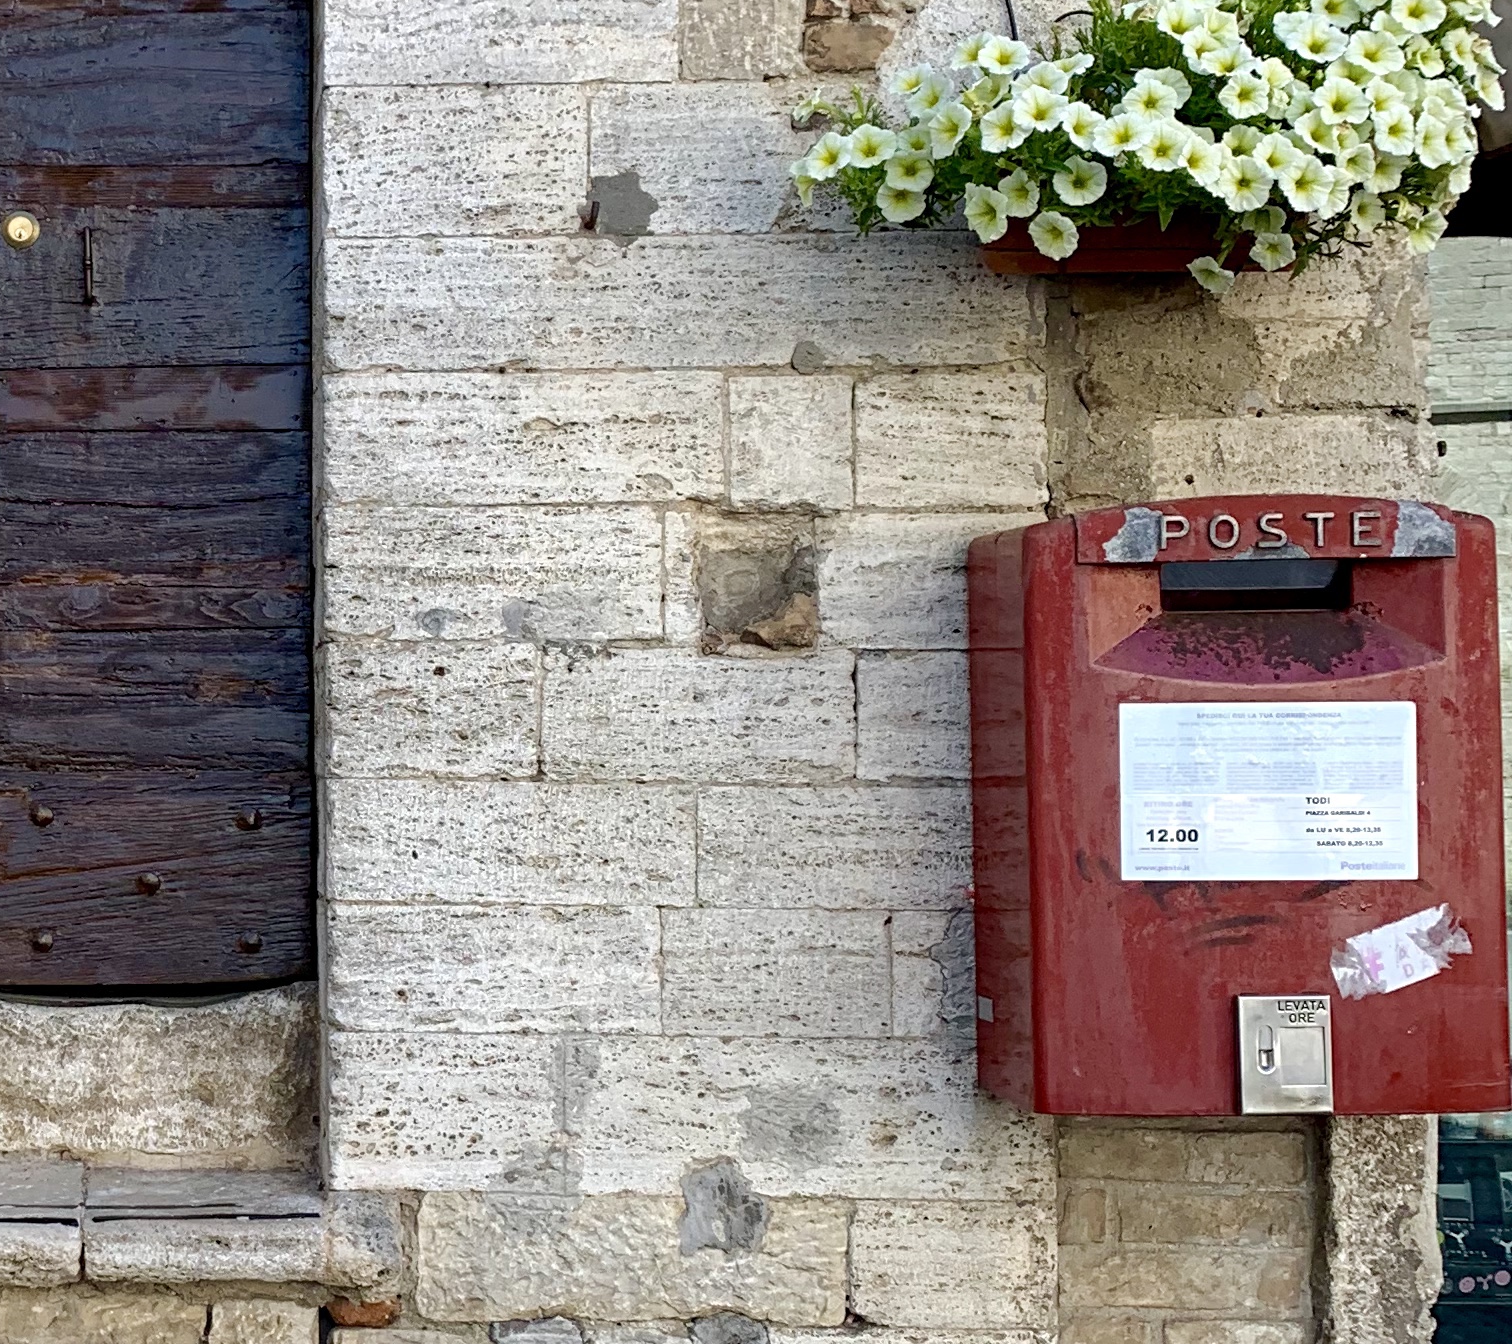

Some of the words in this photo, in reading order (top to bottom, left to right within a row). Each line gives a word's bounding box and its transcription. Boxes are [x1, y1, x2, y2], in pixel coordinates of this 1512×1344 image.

[1160, 510, 1382, 550] POSTE
[1305, 796, 1331, 804] TODI
[1146, 828, 1199, 843] 12.00
[1277, 1000, 1326, 1011] LEVATA
[1289, 1013, 1316, 1023] ORE
